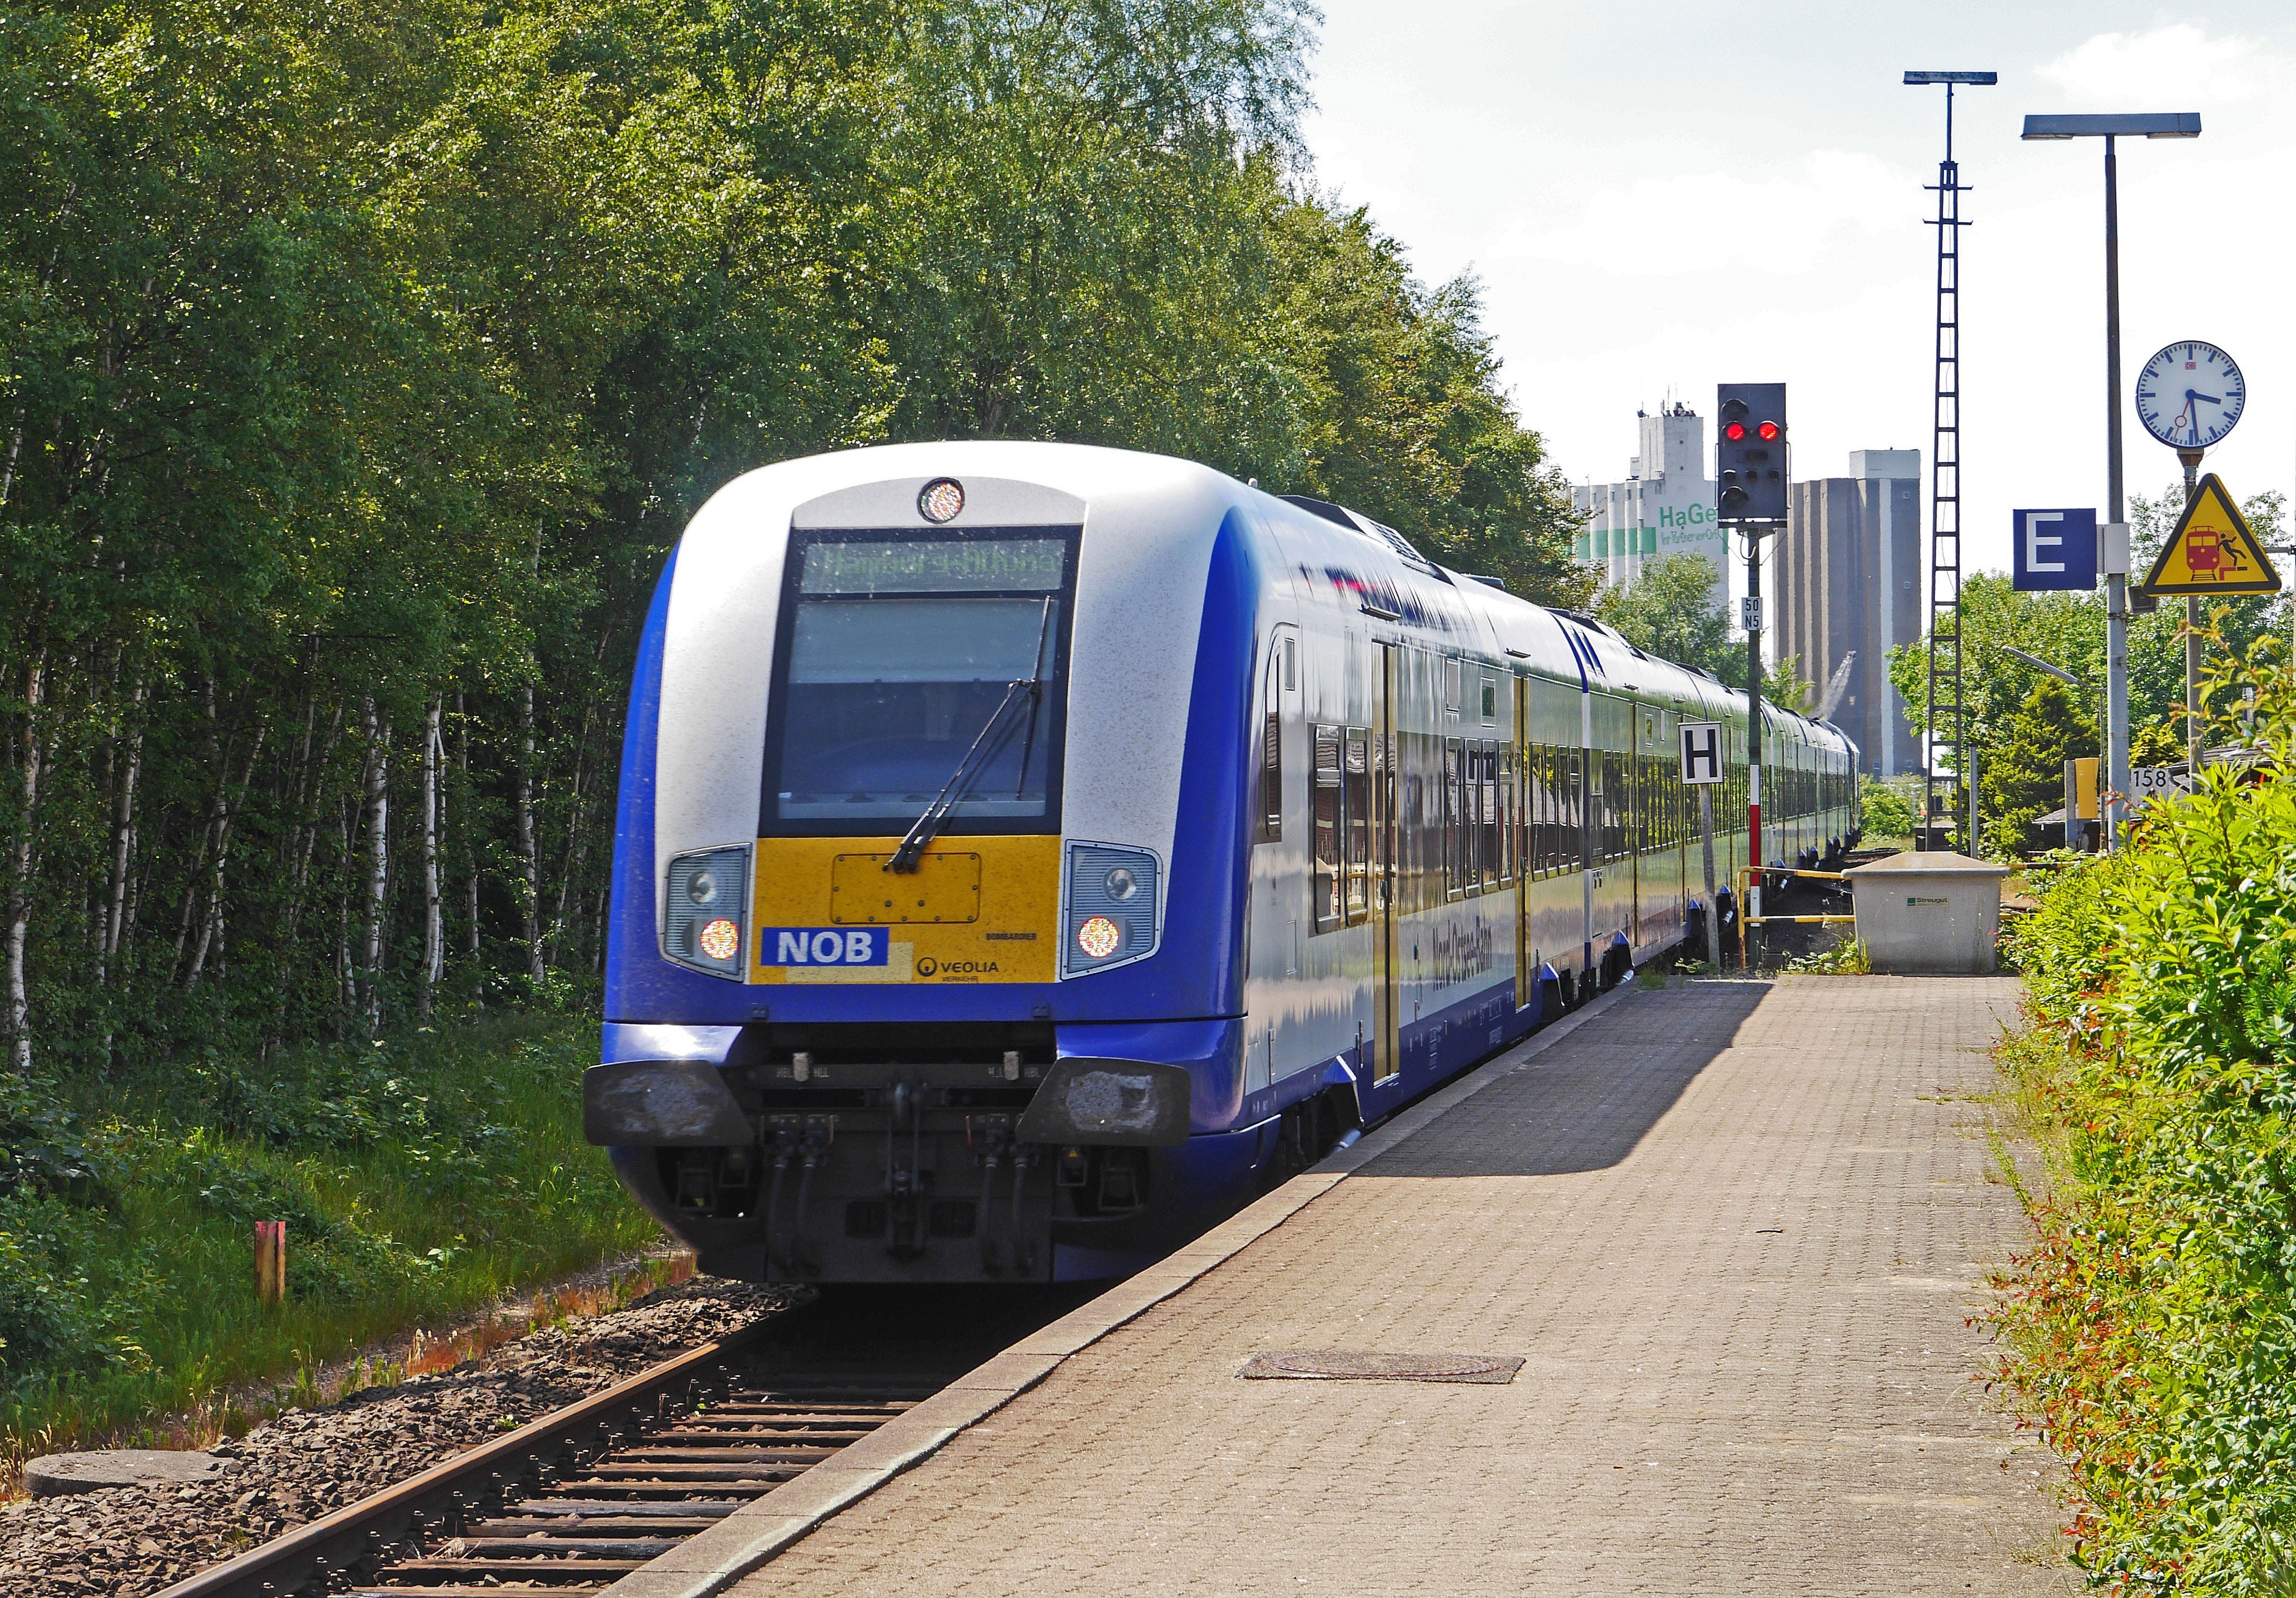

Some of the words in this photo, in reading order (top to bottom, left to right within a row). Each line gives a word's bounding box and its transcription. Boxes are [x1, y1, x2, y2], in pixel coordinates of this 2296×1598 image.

[1660, 503, 1717, 527] HaGe
[2026, 512, 2065, 571] E
[1746, 598, 1759, 611] 50
[1746, 615, 1759, 627] N5
[1684, 729, 1718, 779] H
[2133, 771, 2166, 787] 158
[777, 931, 873, 963] NOB
[941, 962, 999, 972] VEOLIA
